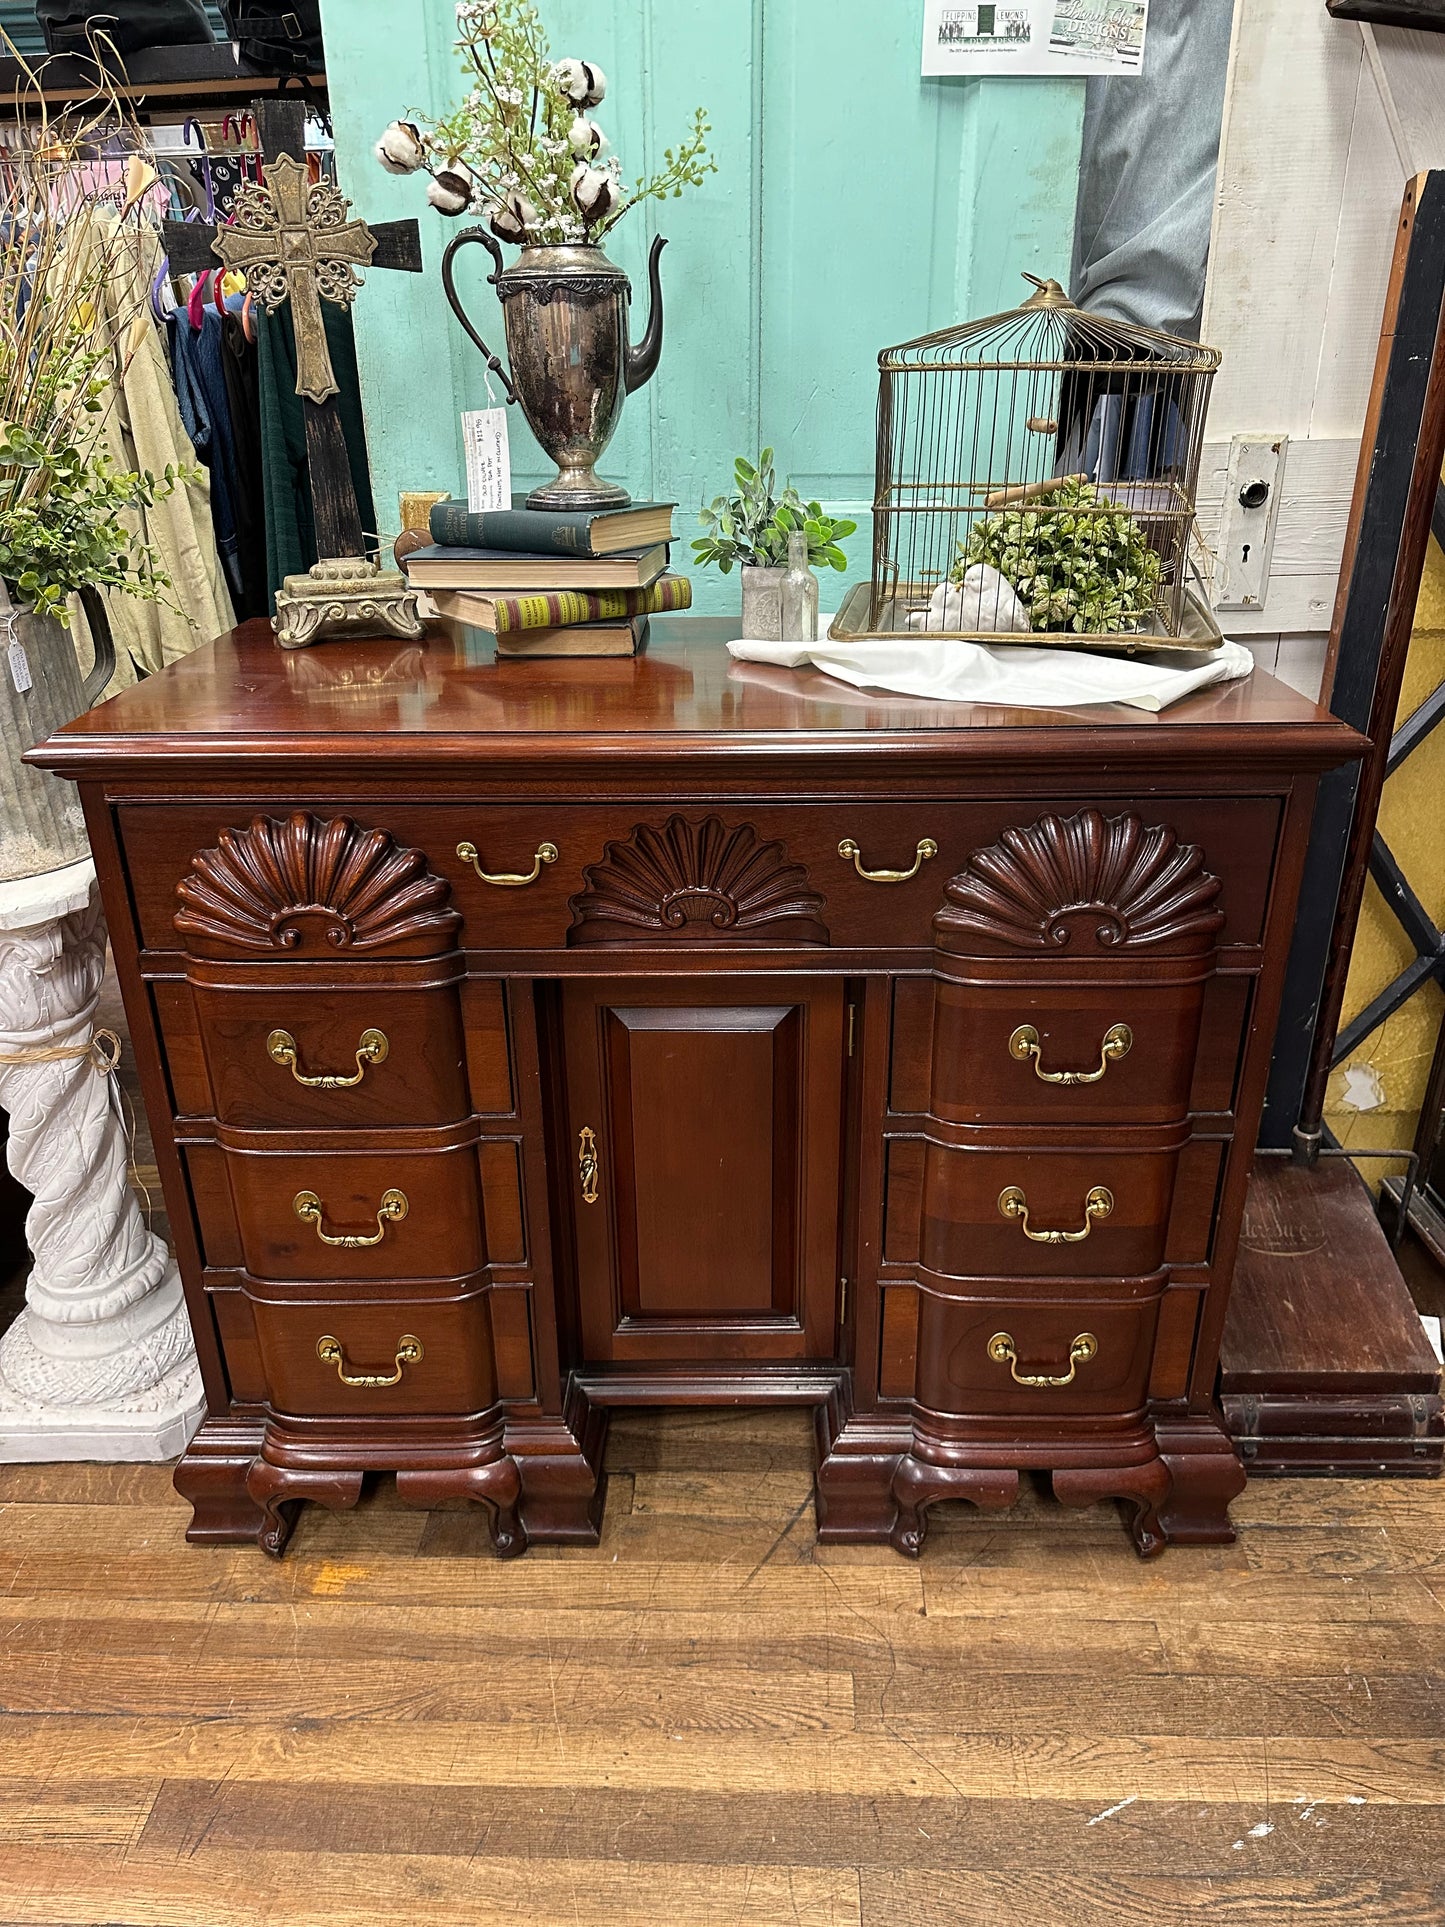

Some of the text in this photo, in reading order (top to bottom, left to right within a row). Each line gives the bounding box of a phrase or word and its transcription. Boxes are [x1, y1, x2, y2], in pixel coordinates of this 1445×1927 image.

[945, 11, 1024, 21] FLIPPING LEMONS
[940, 37, 966, 45] PAINT
[1066, 20, 1128, 40] DESIGNS
[445, 507, 456, 545] The Story
[459, 511, 469, 545] Church
[524, 600, 532, 626] ENGLISH
